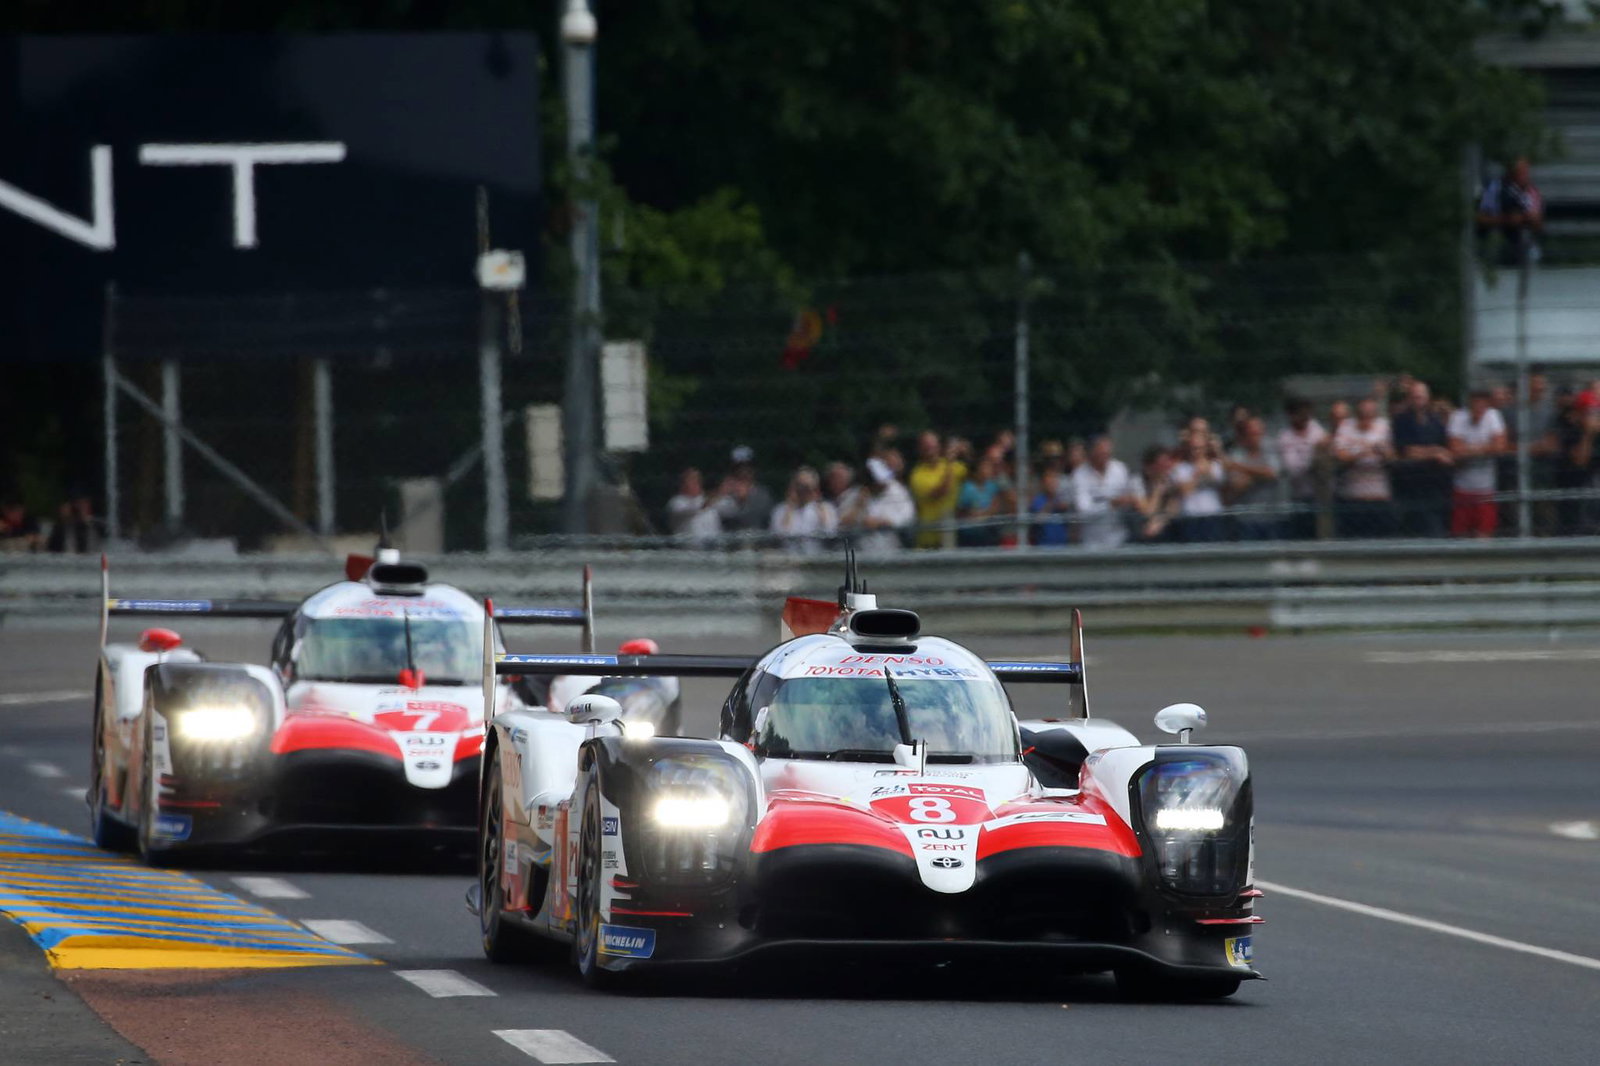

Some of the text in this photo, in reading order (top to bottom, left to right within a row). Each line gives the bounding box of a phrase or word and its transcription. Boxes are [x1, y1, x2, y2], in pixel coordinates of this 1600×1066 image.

[839, 655, 944, 666] DENSO
[804, 665, 883, 676] TOYOTA
[403, 711, 442, 730] 7
[911, 785, 982, 799] TOTAL
[908, 796, 957, 824] 8
[921, 843, 968, 851] ZENT
